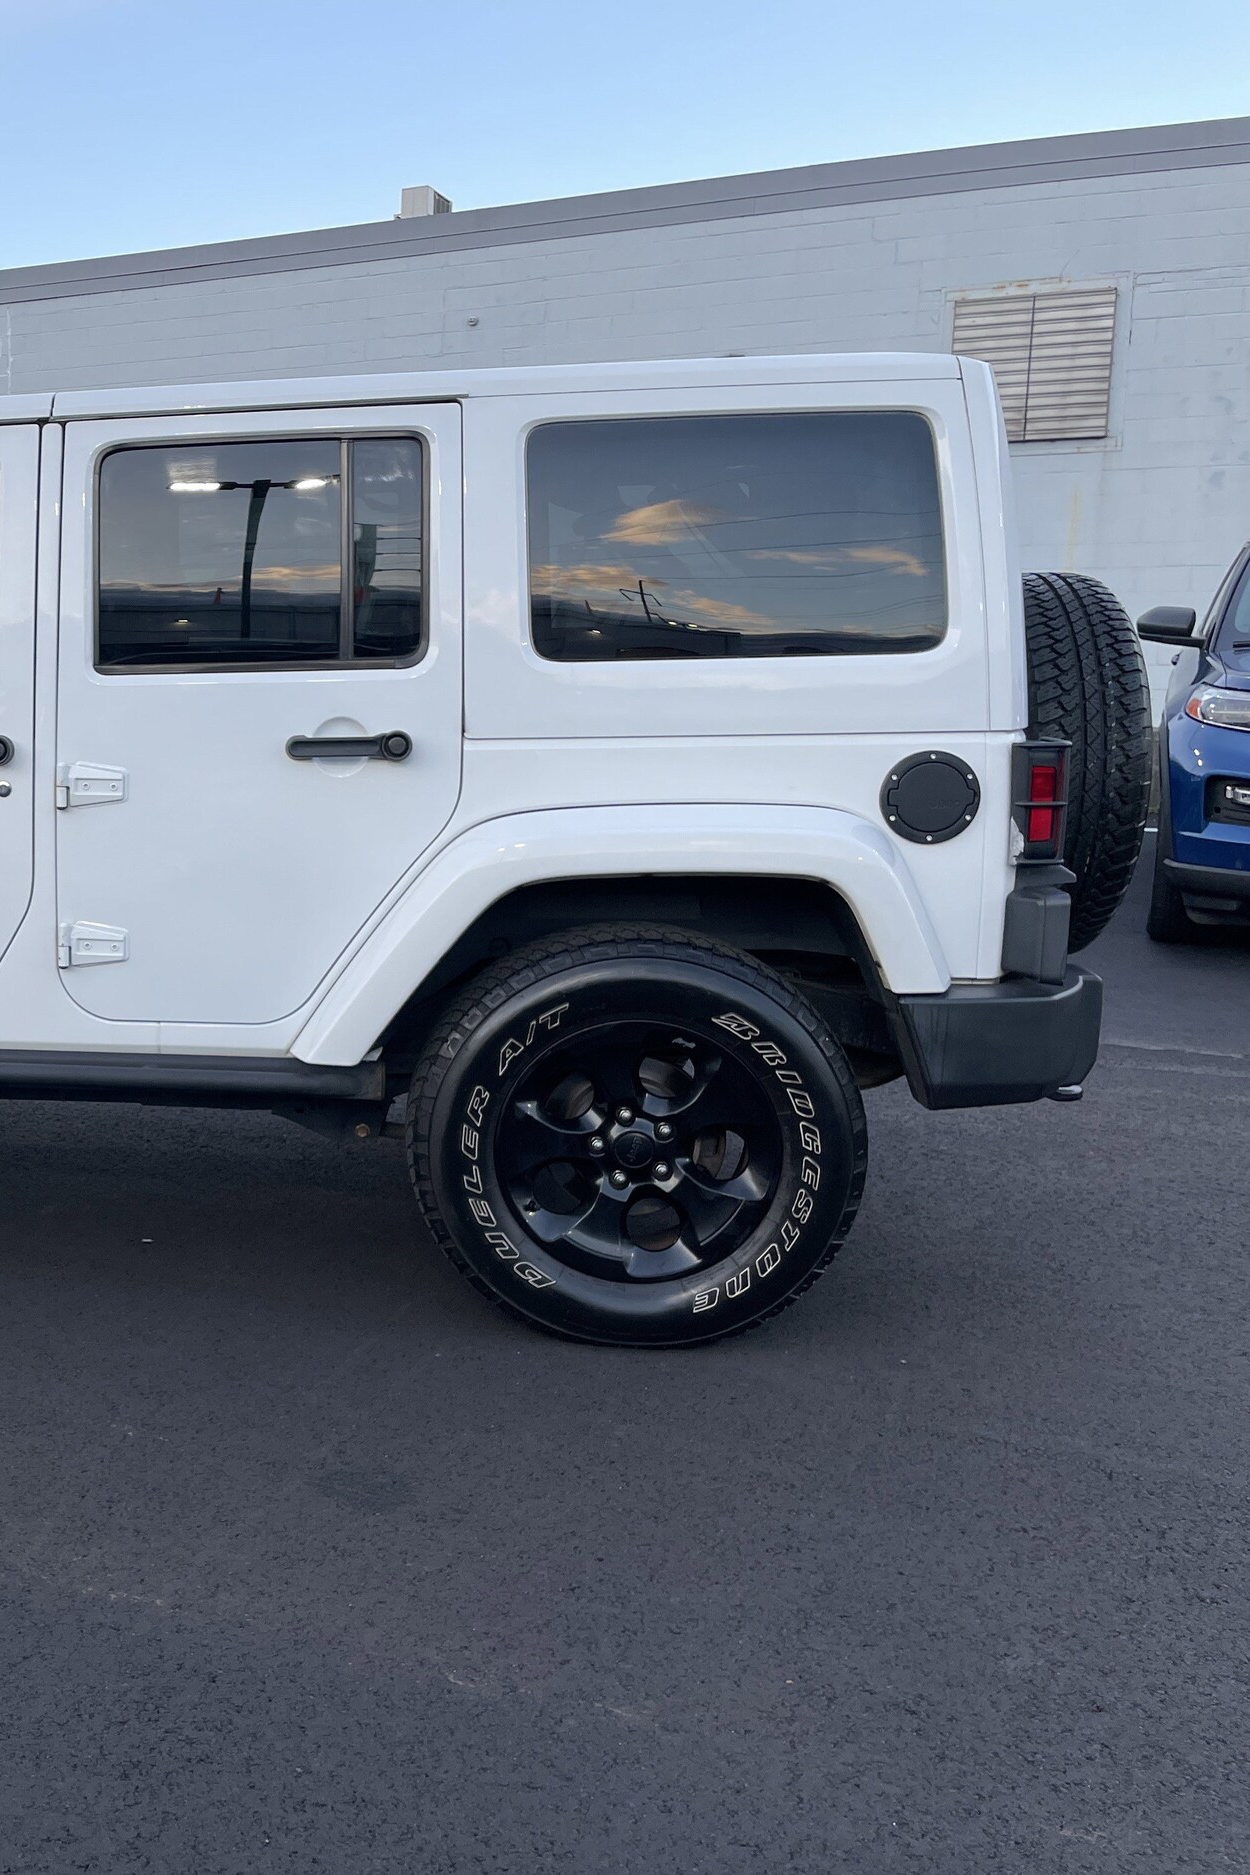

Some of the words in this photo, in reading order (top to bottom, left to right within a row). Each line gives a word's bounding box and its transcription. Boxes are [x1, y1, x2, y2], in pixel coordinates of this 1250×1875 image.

[498, 1002, 570, 1076] A/T
[461, 1085, 557, 1290] DUELER
[693, 1012, 822, 1314] BRIDGESTONE
